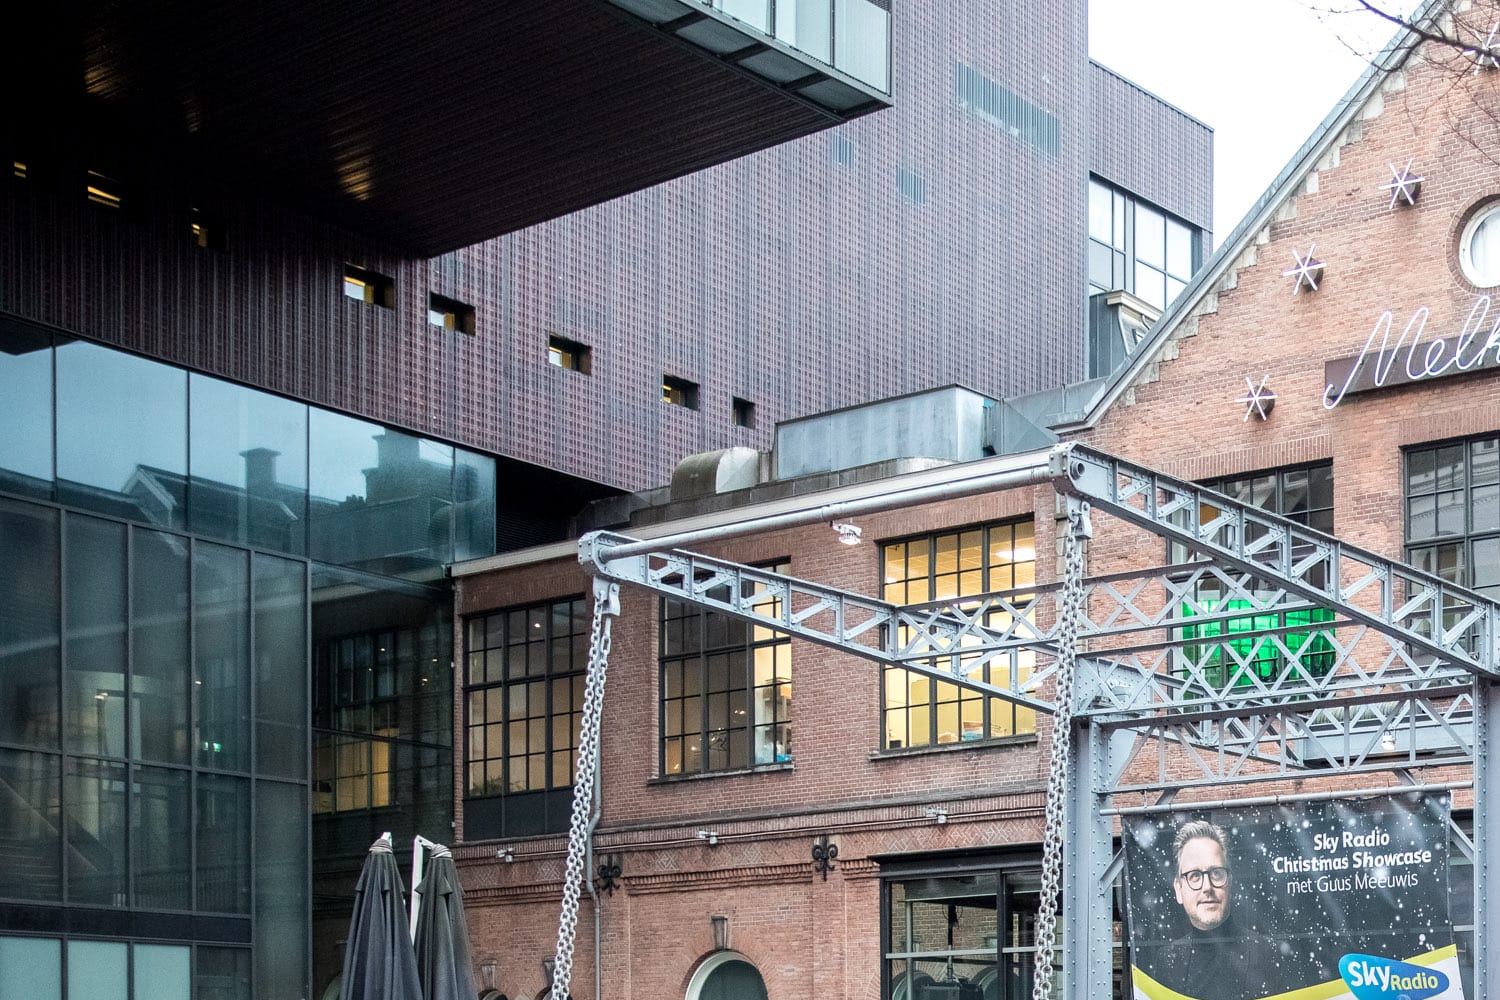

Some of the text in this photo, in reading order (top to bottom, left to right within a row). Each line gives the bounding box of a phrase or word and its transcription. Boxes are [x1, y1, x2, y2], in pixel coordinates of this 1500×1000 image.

[1313, 829, 1390, 854] Sky Radio
[1273, 849, 1432, 874] Christmas Showcase
[1287, 872, 1419, 894] met Guus Meeuwis
[1347, 960, 1439, 992] Sky Radio
